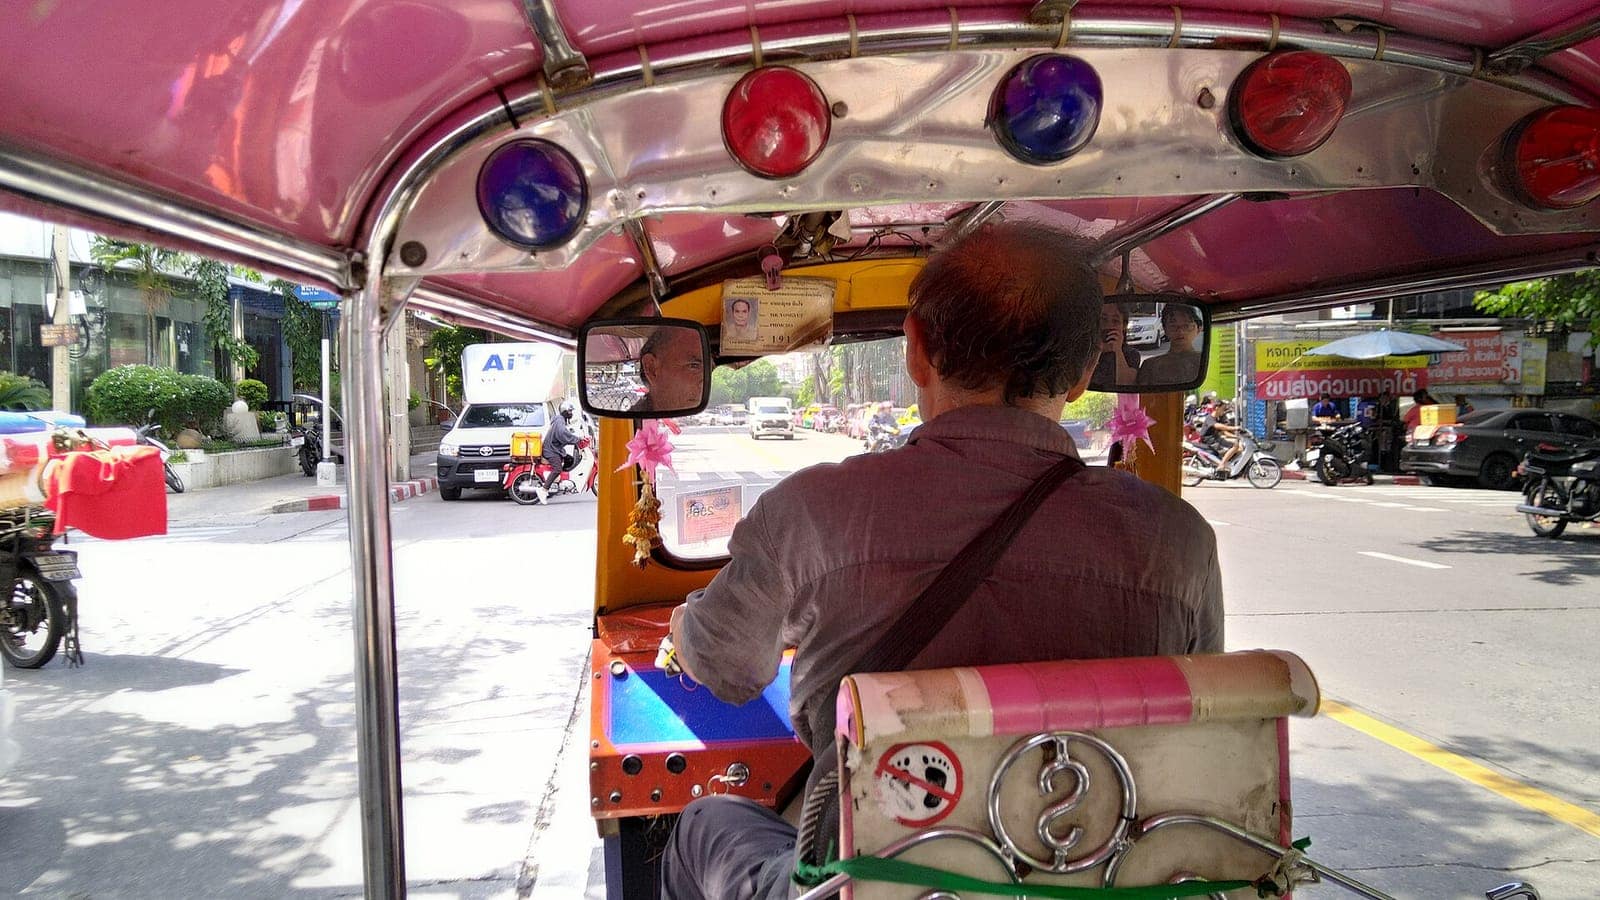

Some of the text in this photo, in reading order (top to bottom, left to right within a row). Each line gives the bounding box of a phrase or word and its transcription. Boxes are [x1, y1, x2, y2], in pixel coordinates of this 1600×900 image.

[1266, 370, 1418, 397] ขนส่งด่วนภาคใต้
